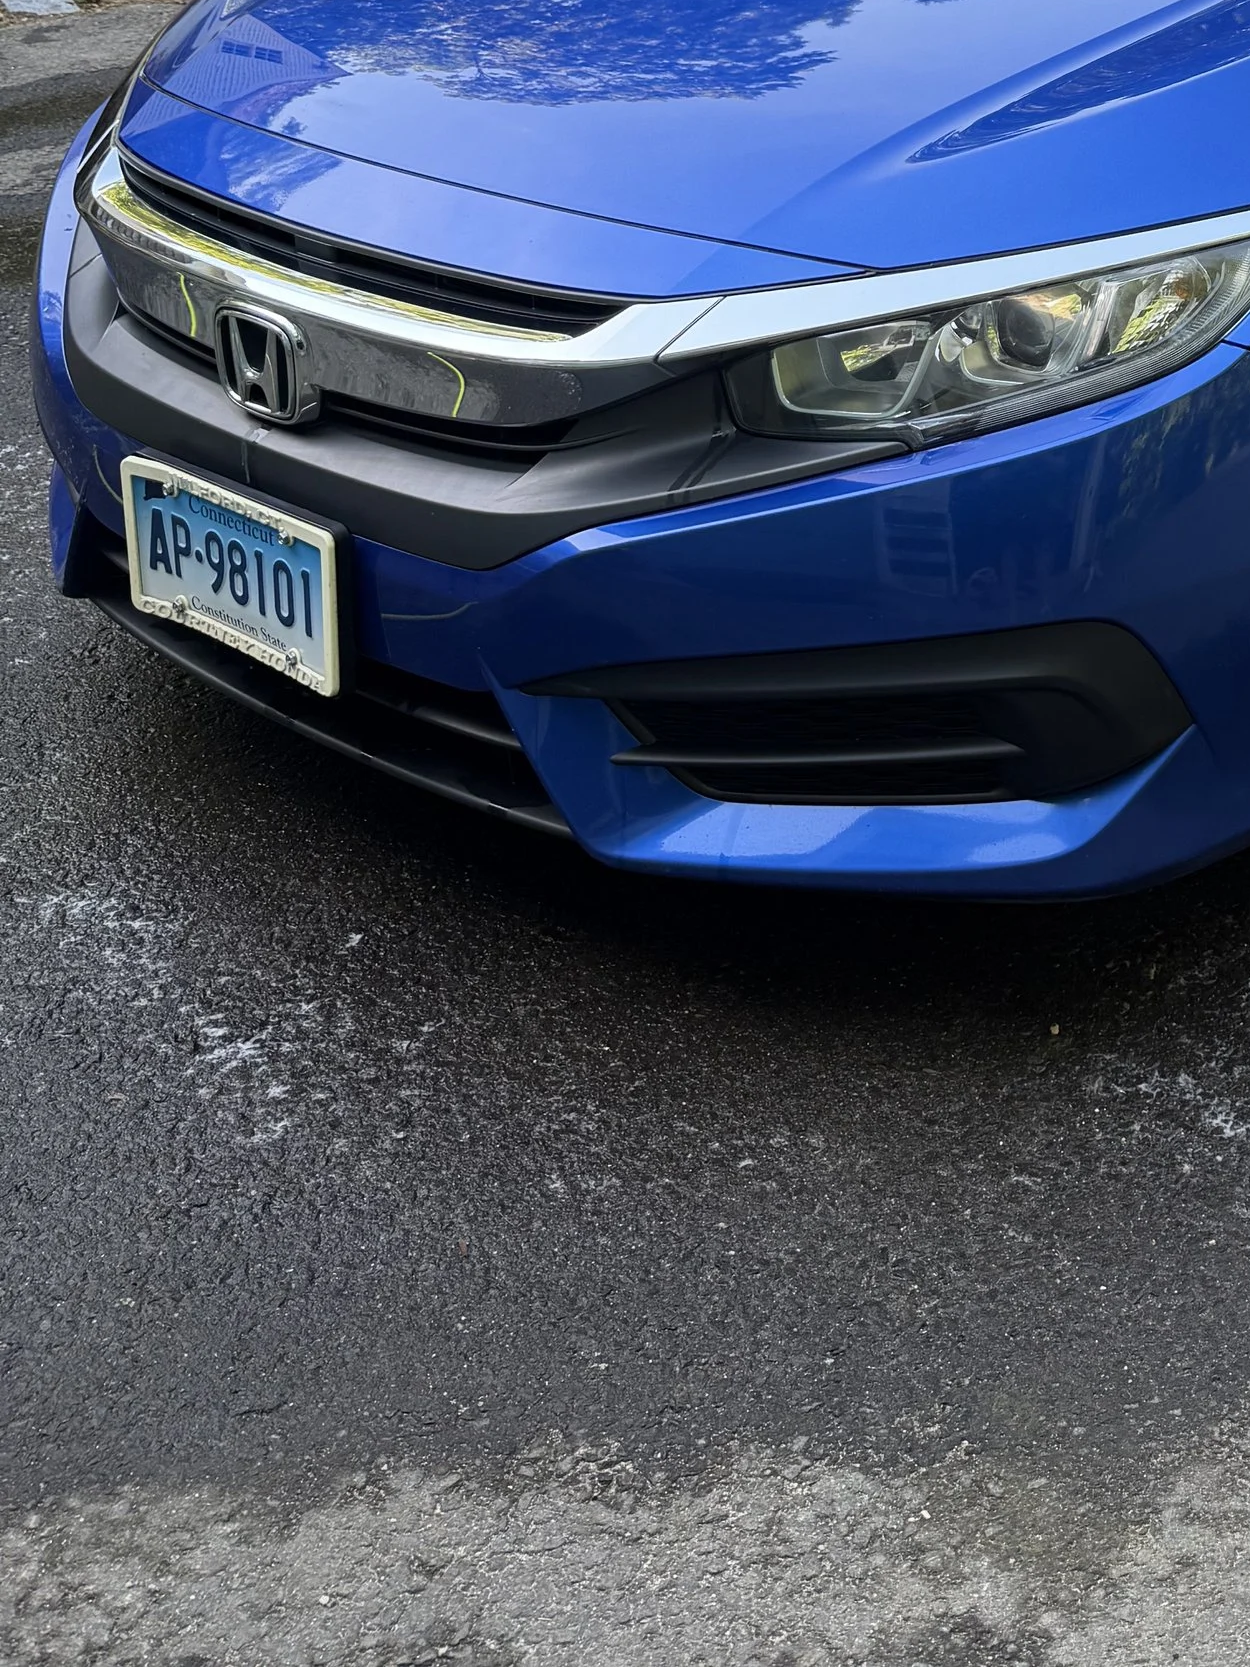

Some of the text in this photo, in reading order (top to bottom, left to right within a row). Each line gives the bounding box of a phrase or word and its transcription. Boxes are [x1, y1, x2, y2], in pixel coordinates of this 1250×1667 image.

[188, 496, 276, 546] Connecticut
[191, 595, 287, 651] Constitution State
